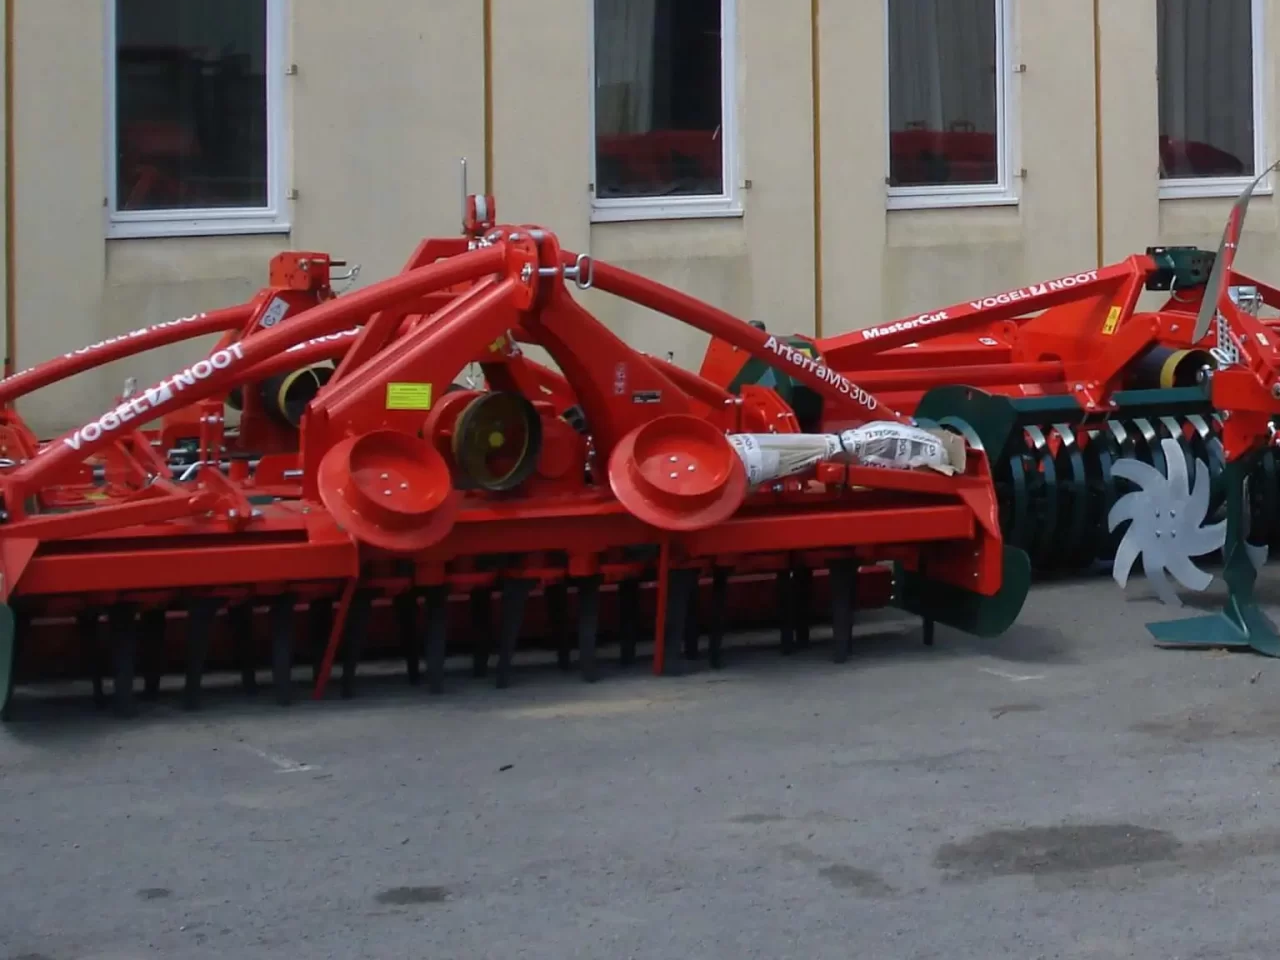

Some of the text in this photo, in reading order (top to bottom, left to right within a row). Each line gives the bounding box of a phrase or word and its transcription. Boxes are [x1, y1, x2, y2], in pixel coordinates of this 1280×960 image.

[970, 270, 1099, 310] VOGEL NOOT
[862, 310, 949, 340] MasterCut
[63, 396, 149, 450] VOGEL
[172, 342, 244, 390] NOOT
